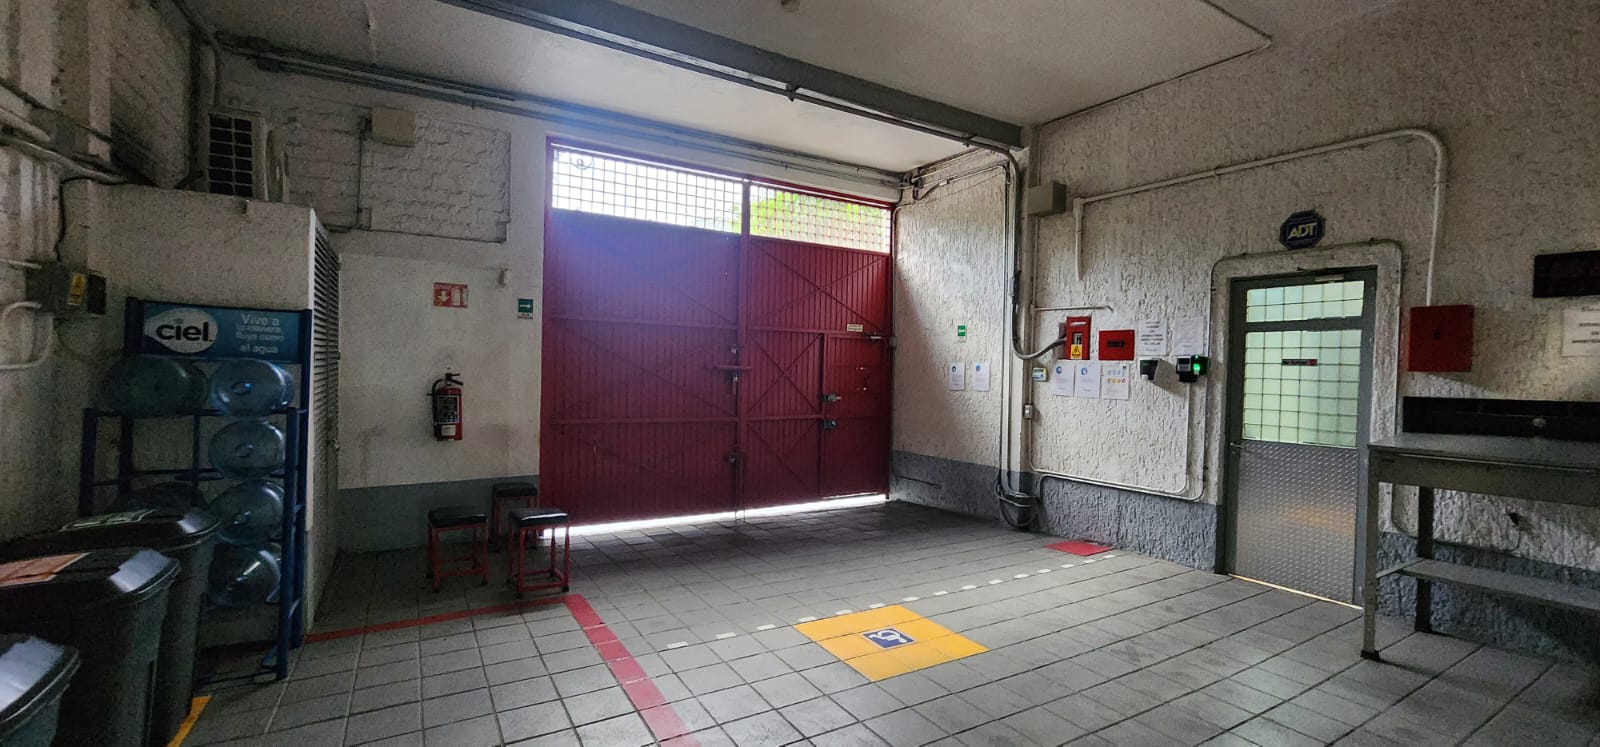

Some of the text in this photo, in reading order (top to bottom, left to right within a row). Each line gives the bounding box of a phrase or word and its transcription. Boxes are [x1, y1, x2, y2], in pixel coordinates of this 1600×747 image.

[1287, 222, 1317, 240] ADT
[241, 313, 280, 326] Vive a
[156, 319, 210, 342] ciel
[240, 344, 279, 355] el agua
